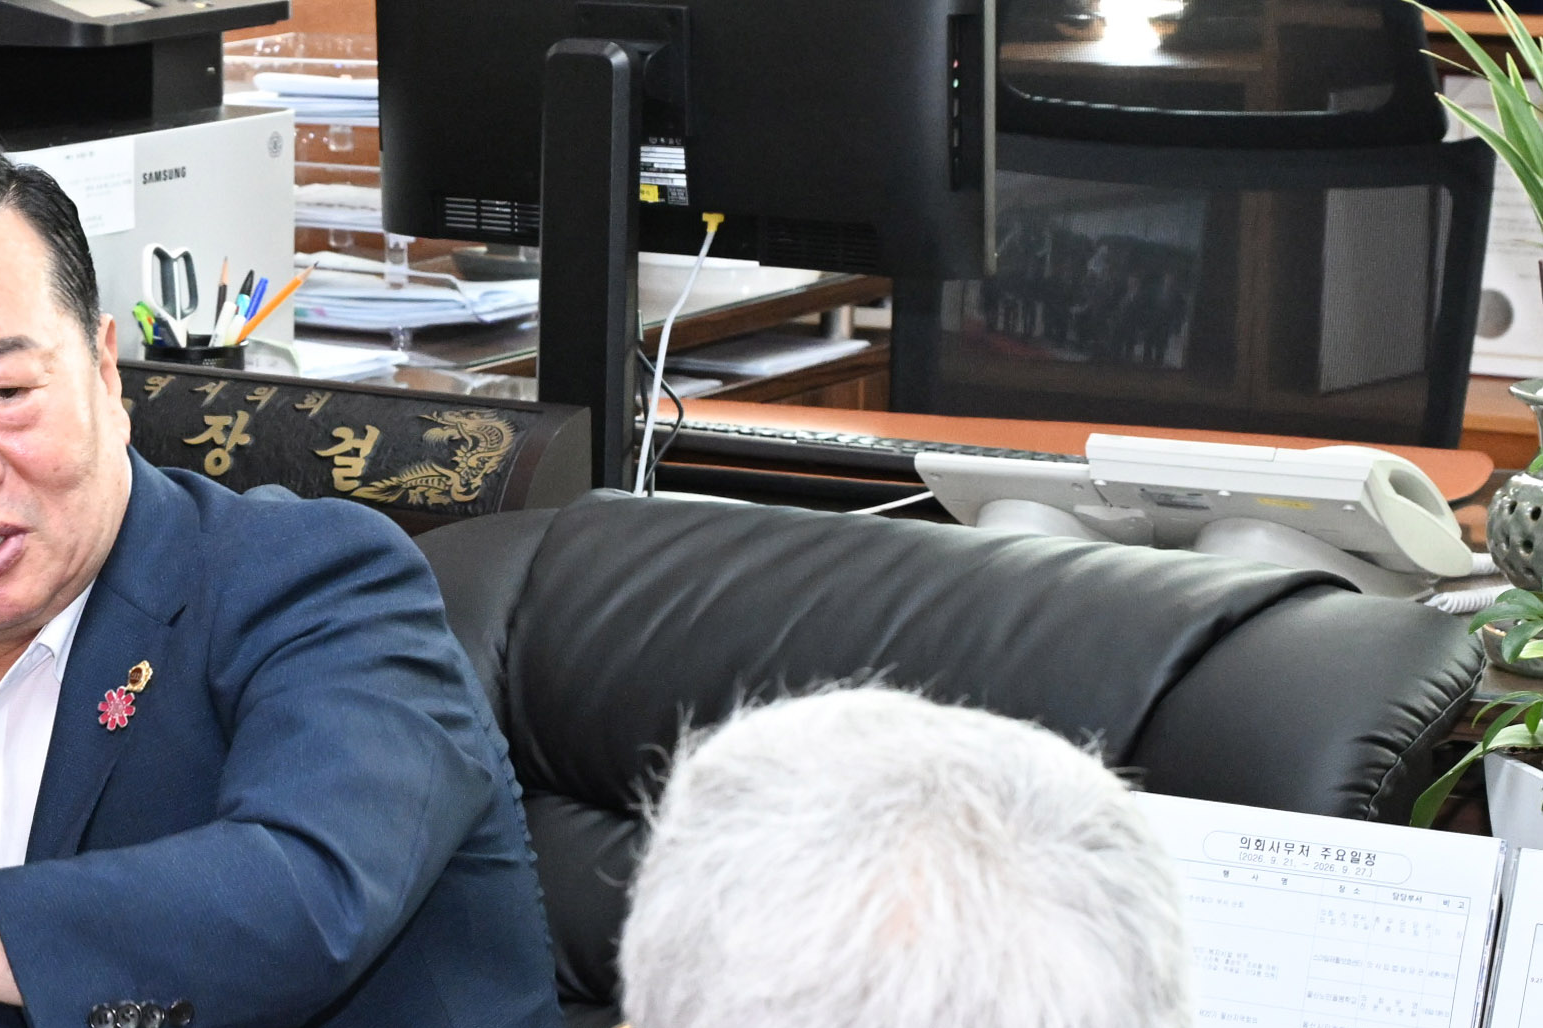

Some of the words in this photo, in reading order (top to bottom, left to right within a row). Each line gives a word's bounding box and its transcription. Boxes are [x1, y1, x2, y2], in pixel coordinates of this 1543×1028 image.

[142, 166, 187, 185] SAMSUNG
[183, 410, 251, 477] 장
[314, 424, 381, 492] 걸
[1238, 836, 1310, 858] 의회사무처
[1320, 846, 1377, 867] 주요일정
